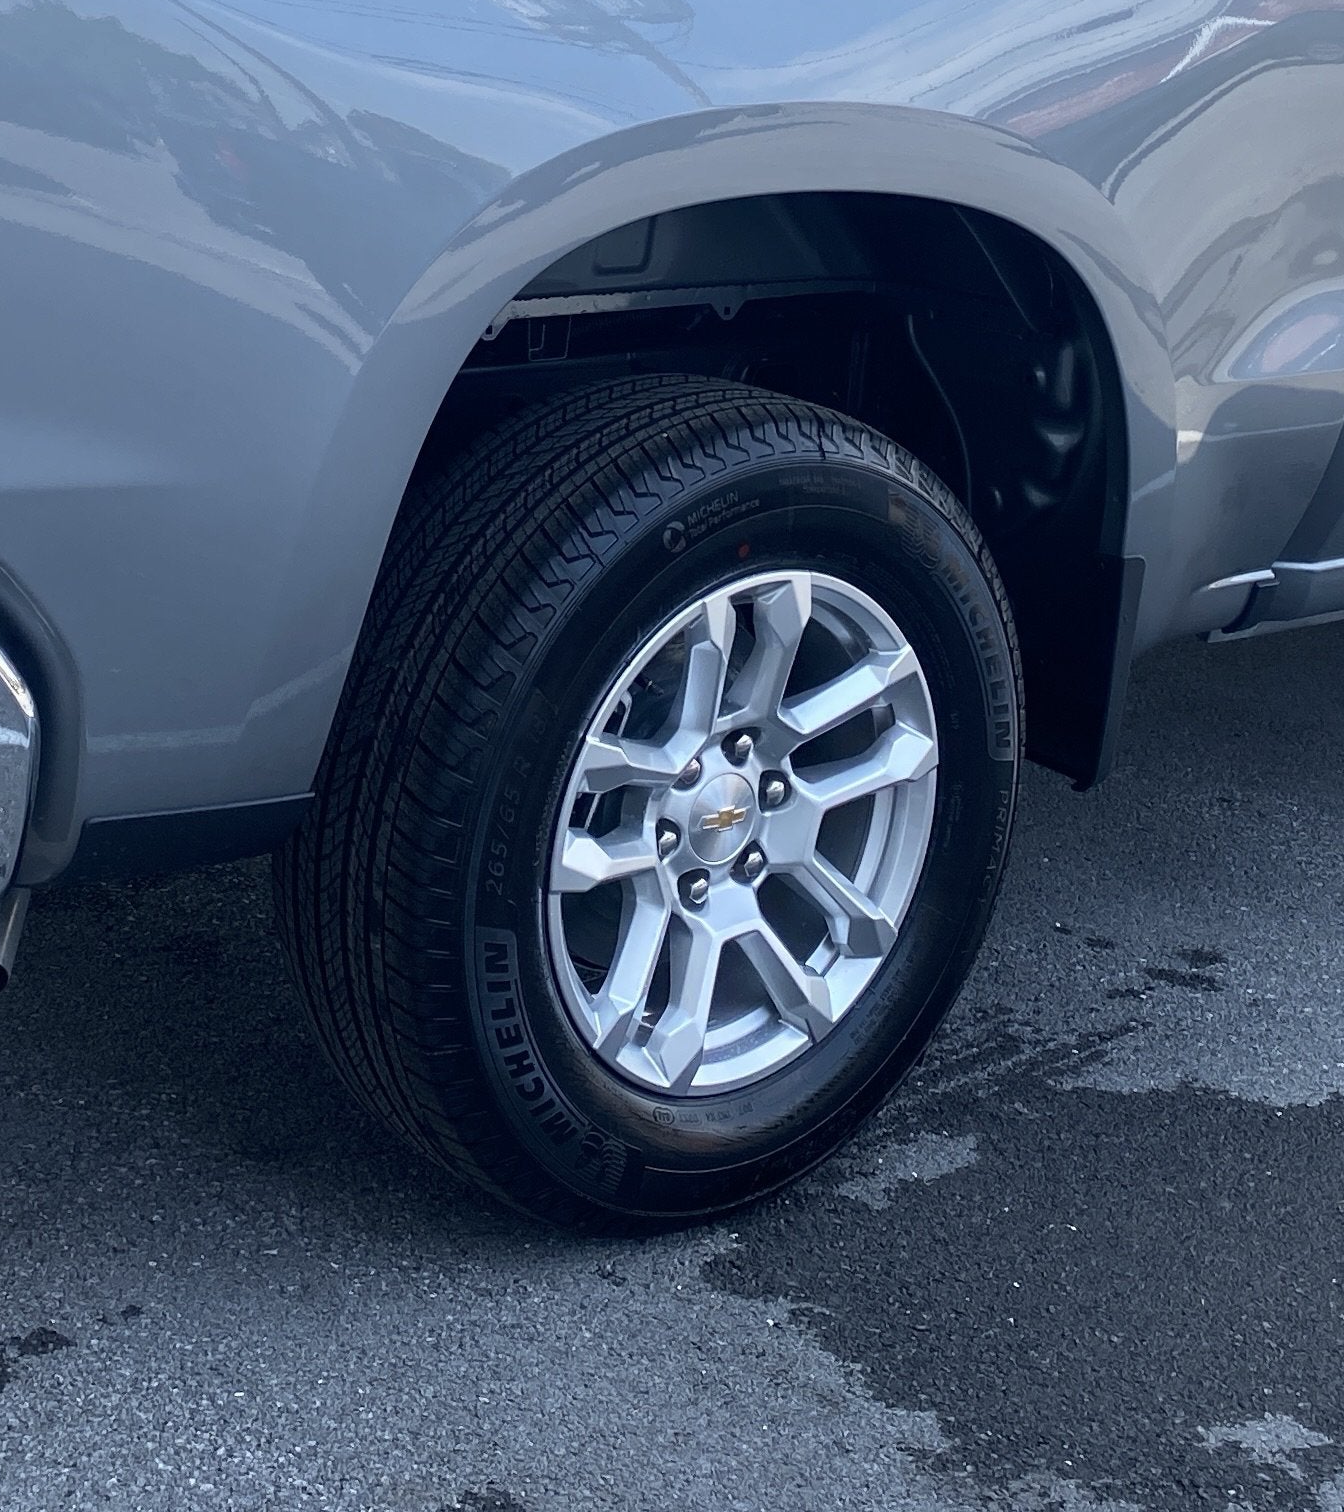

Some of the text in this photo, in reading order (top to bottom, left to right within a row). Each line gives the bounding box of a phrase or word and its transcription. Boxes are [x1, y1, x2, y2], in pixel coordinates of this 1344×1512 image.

[686, 490, 740, 527] MICHELIN
[940, 552, 1011, 749] MICHELIN
[482, 941, 580, 1147] MICHELIN
